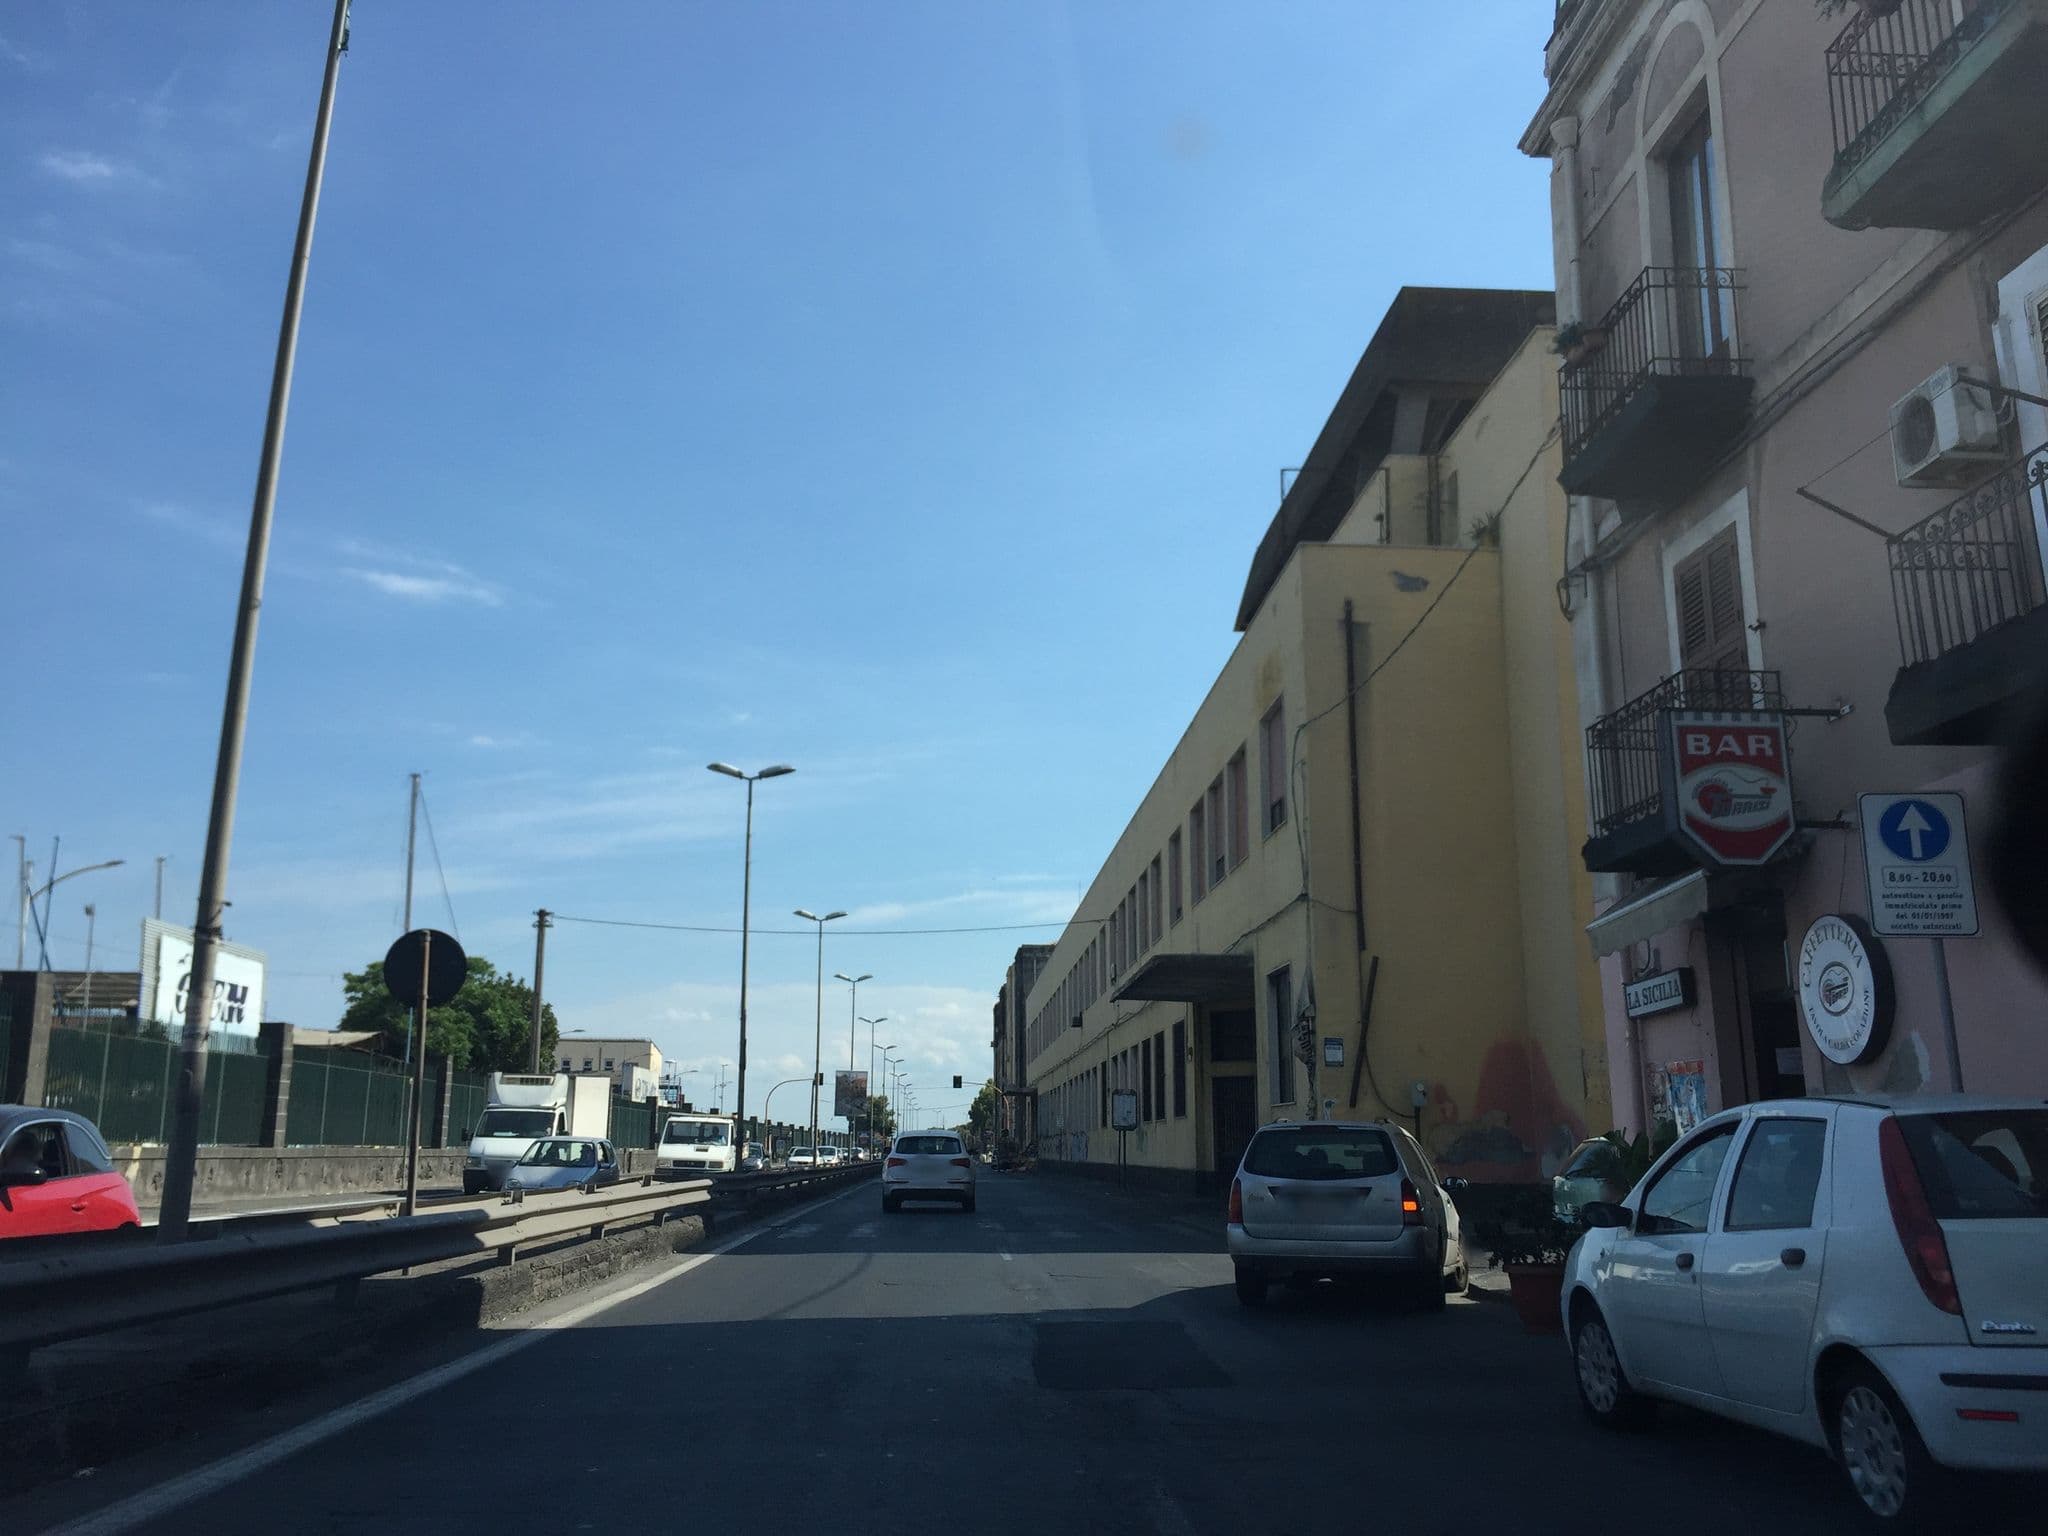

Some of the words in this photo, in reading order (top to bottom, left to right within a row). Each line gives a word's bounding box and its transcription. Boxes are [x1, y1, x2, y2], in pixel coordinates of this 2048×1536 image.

[1685, 733, 1774, 757] BAR
[1941, 902, 1962, 910] prima
[1802, 922, 1864, 988] CAFFETTERIA
[1627, 991, 1641, 1010] LA
[1642, 978, 1682, 1006] SICILIA
